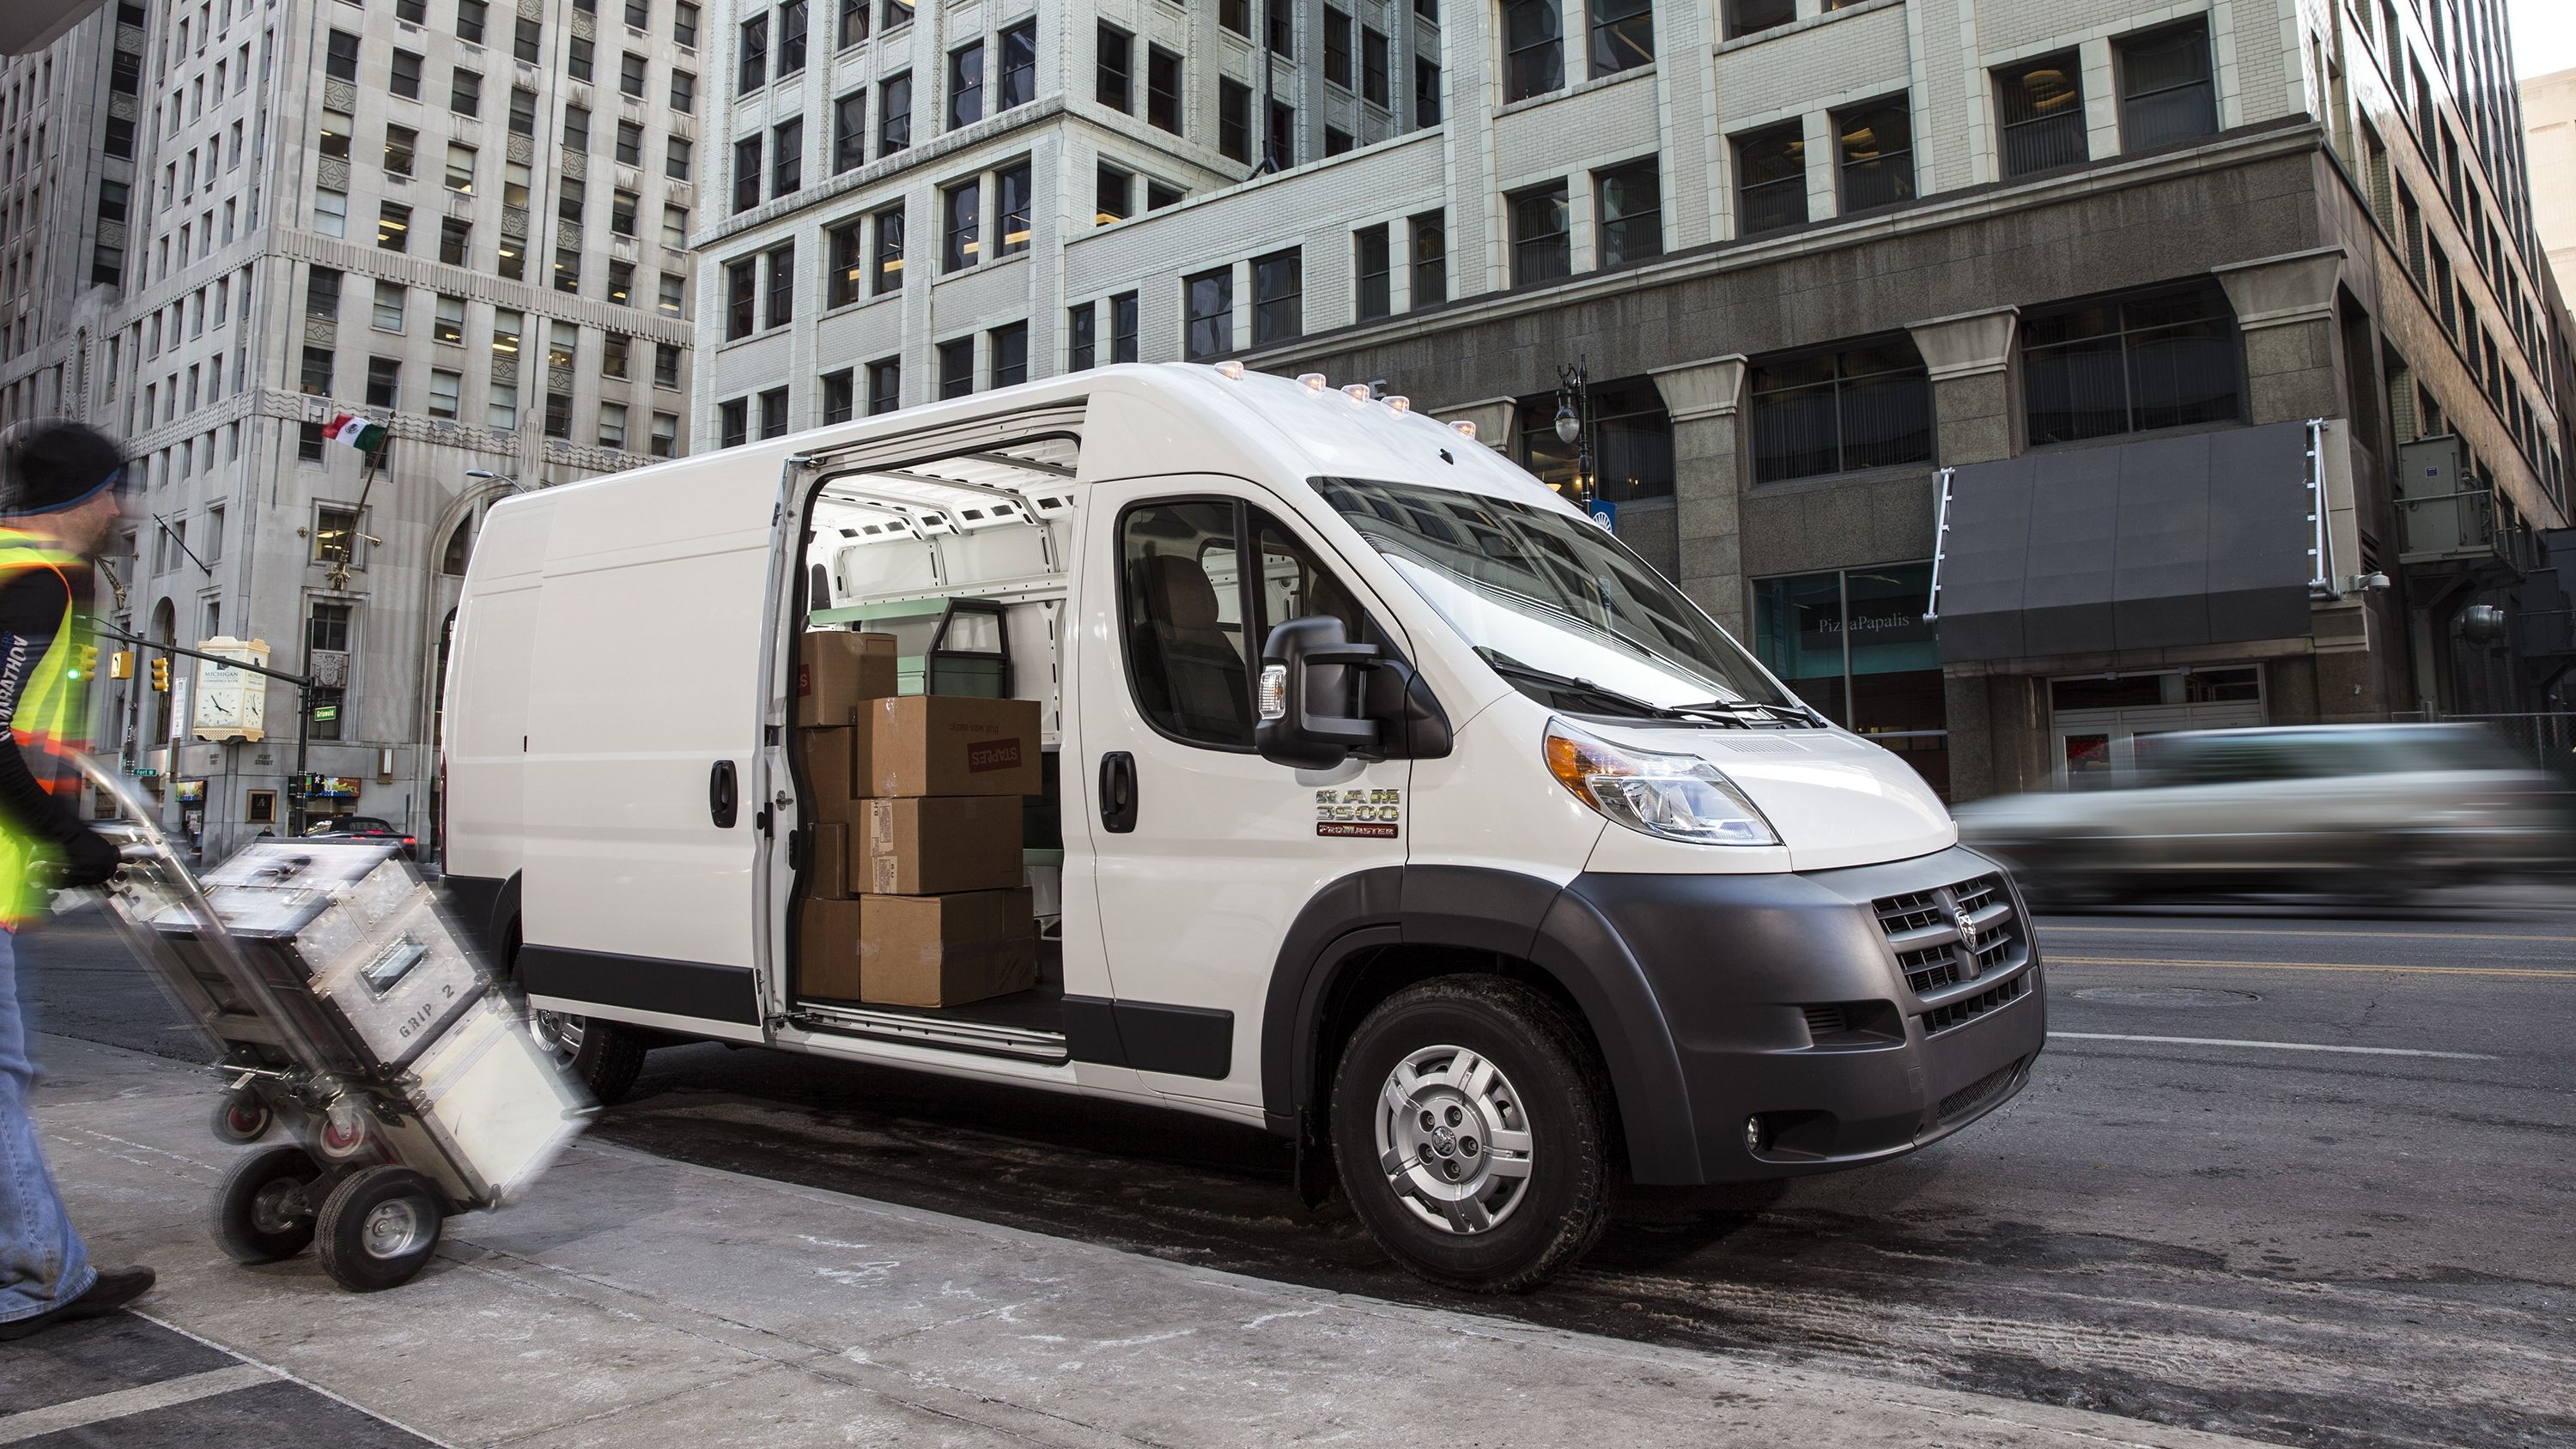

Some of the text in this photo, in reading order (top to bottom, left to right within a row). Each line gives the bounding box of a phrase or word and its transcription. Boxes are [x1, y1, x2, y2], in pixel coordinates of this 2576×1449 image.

[1820, 612, 1910, 633] PizaPapalis
[971, 747, 1018, 766] STAPLES
[1316, 790, 1400, 803] RAM
[1316, 806, 1399, 822] 3500
[398, 984, 454, 1038] GRIP 2
